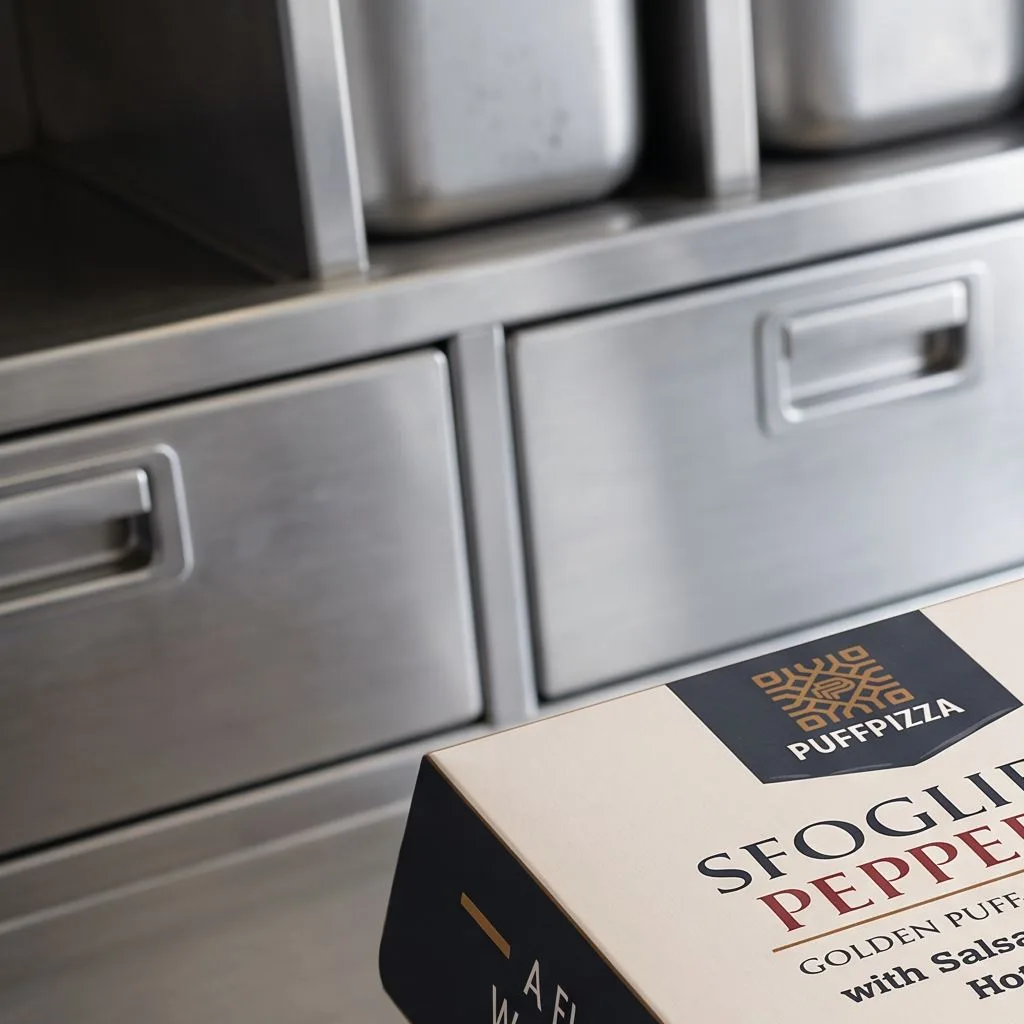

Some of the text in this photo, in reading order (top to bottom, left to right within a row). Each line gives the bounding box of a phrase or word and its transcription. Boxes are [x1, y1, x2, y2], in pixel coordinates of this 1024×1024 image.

[787, 699, 965, 760] PUFFPIZZA
[800, 920, 940, 974] GOLDEN
[522, 959, 542, 1012] A
[841, 967, 928, 1002] with
